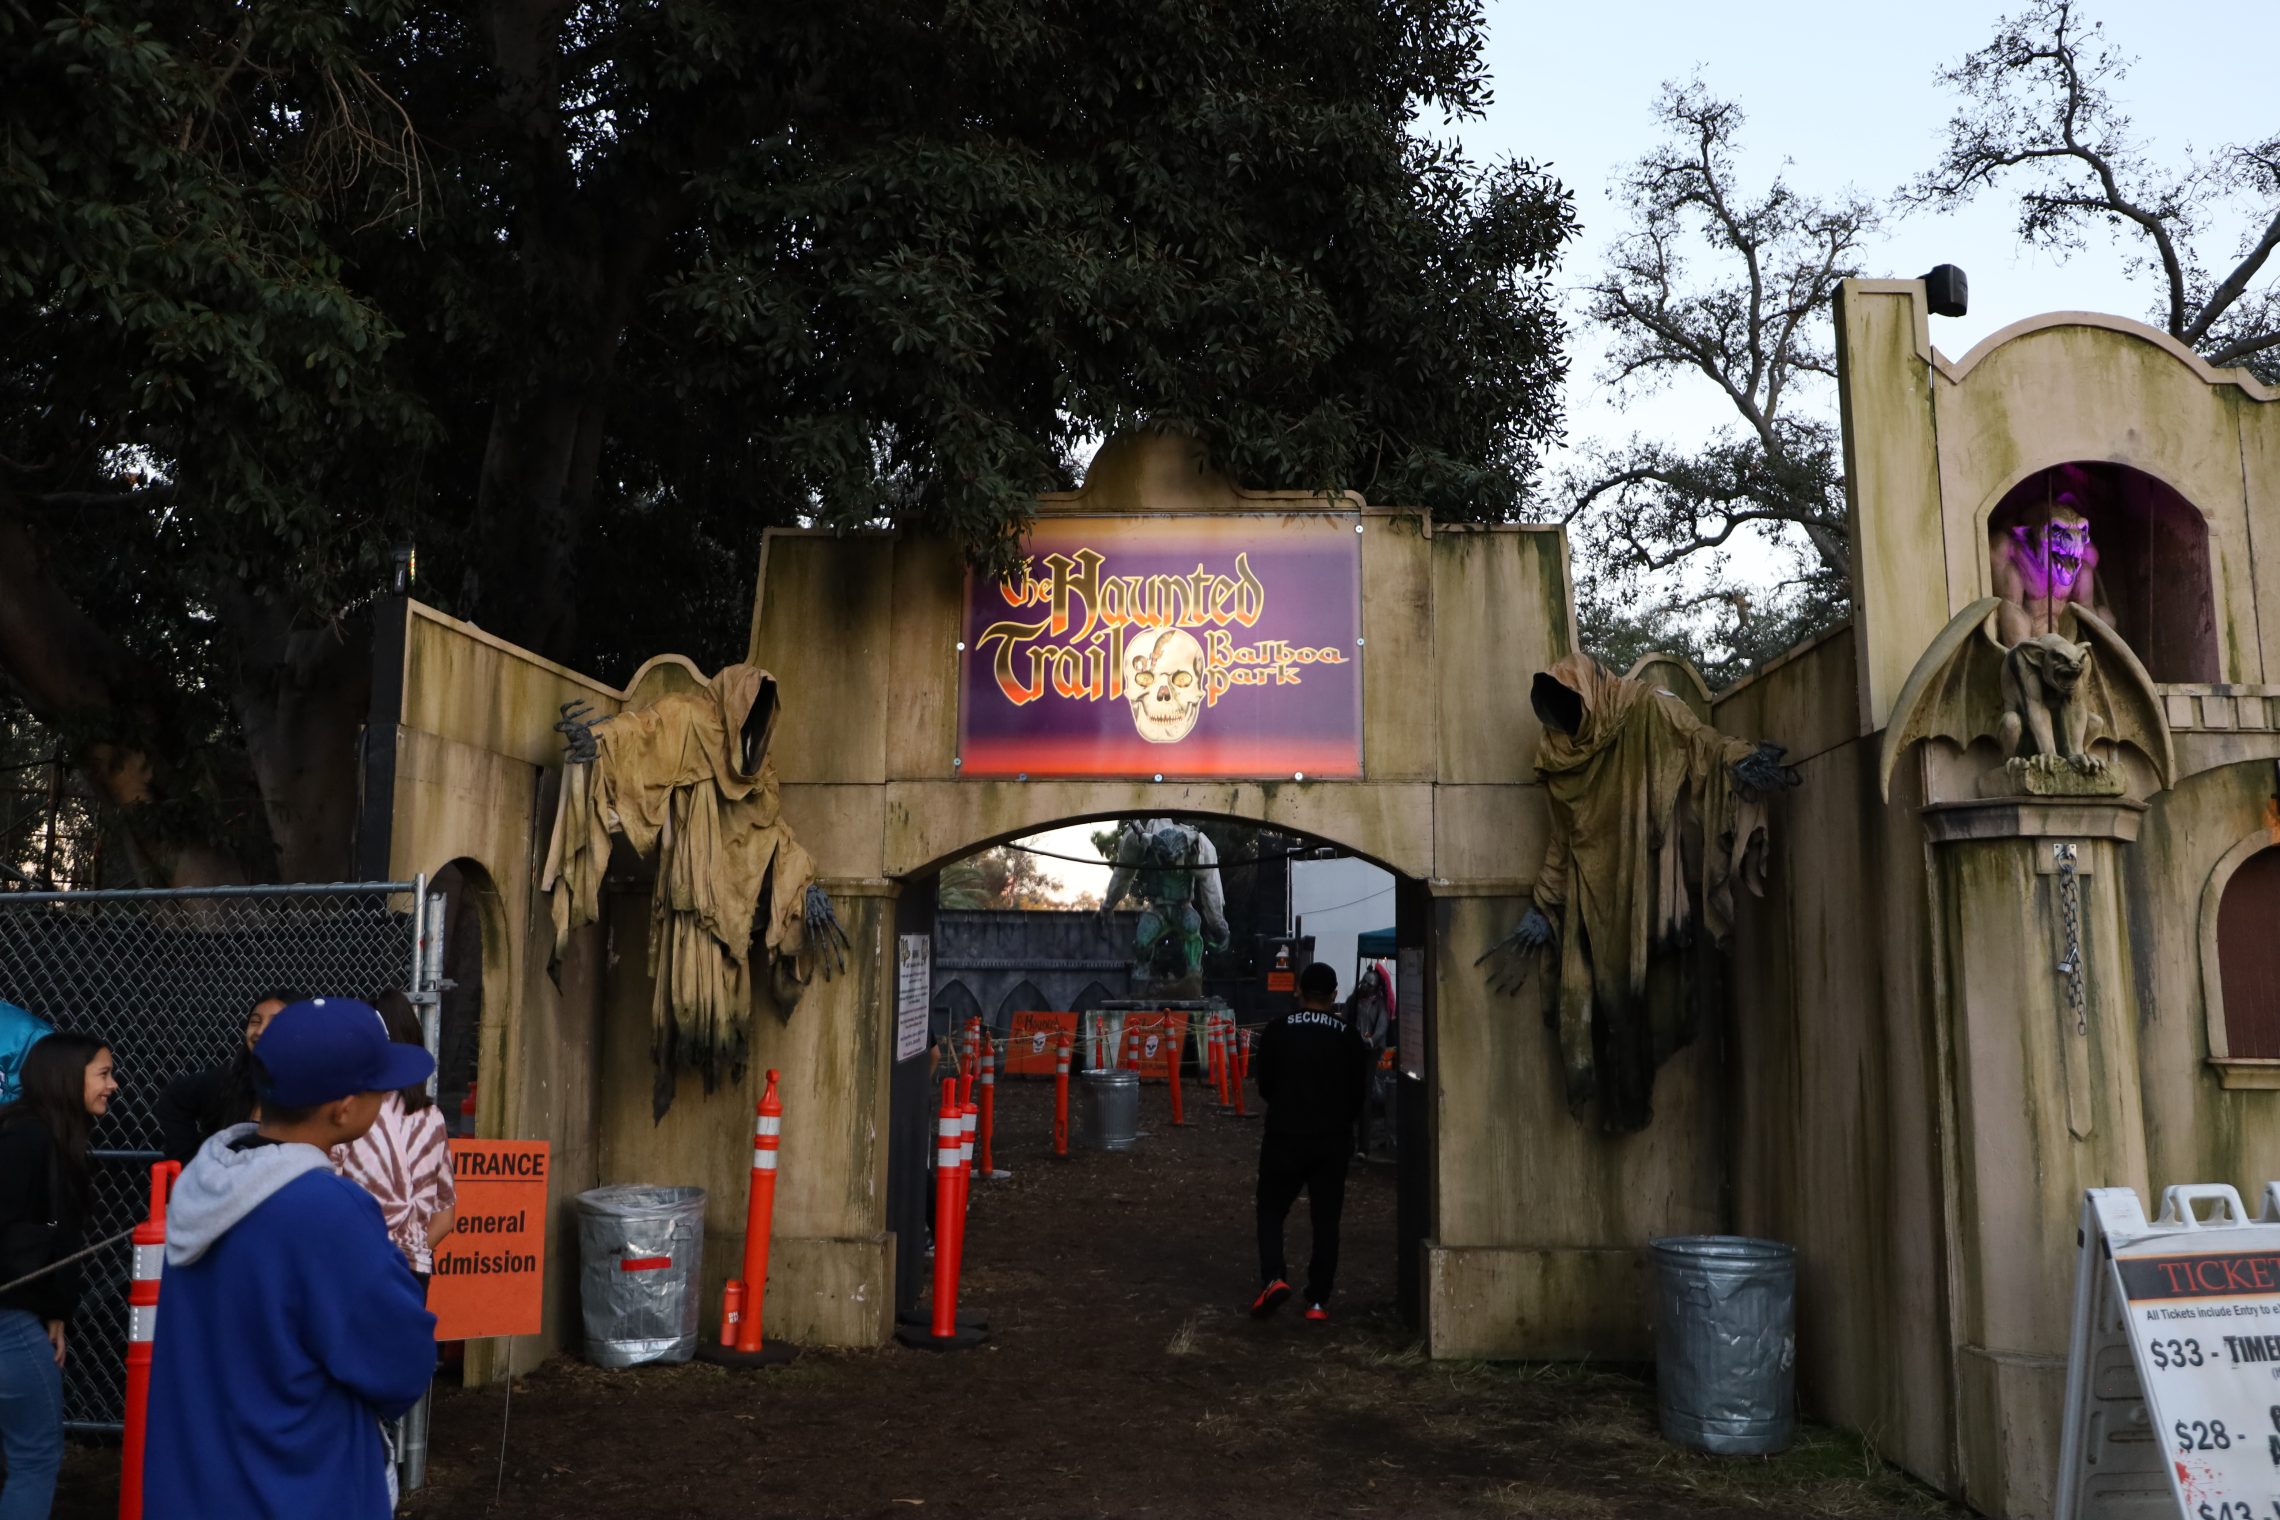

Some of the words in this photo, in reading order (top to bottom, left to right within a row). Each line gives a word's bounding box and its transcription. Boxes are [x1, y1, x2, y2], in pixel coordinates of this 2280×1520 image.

[1043, 547, 1264, 644] Haunted
[976, 617, 1124, 707] Trail
[1204, 630, 1349, 667] Balboa
[1287, 1011, 1347, 1032] SECURITY
[451, 1210, 525, 1234] eneral
[2147, 1309, 2159, 1321] All
[2160, 1308, 2196, 1320] Tickets
[2198, 1307, 2232, 1318] include
[2233, 1305, 2258, 1317] Entry
[2260, 1305, 2270, 1315] to
[2150, 1337, 2205, 1371] $33
[2175, 1418, 2231, 1453] $28
[2198, 1500, 2254, 1520] $43
